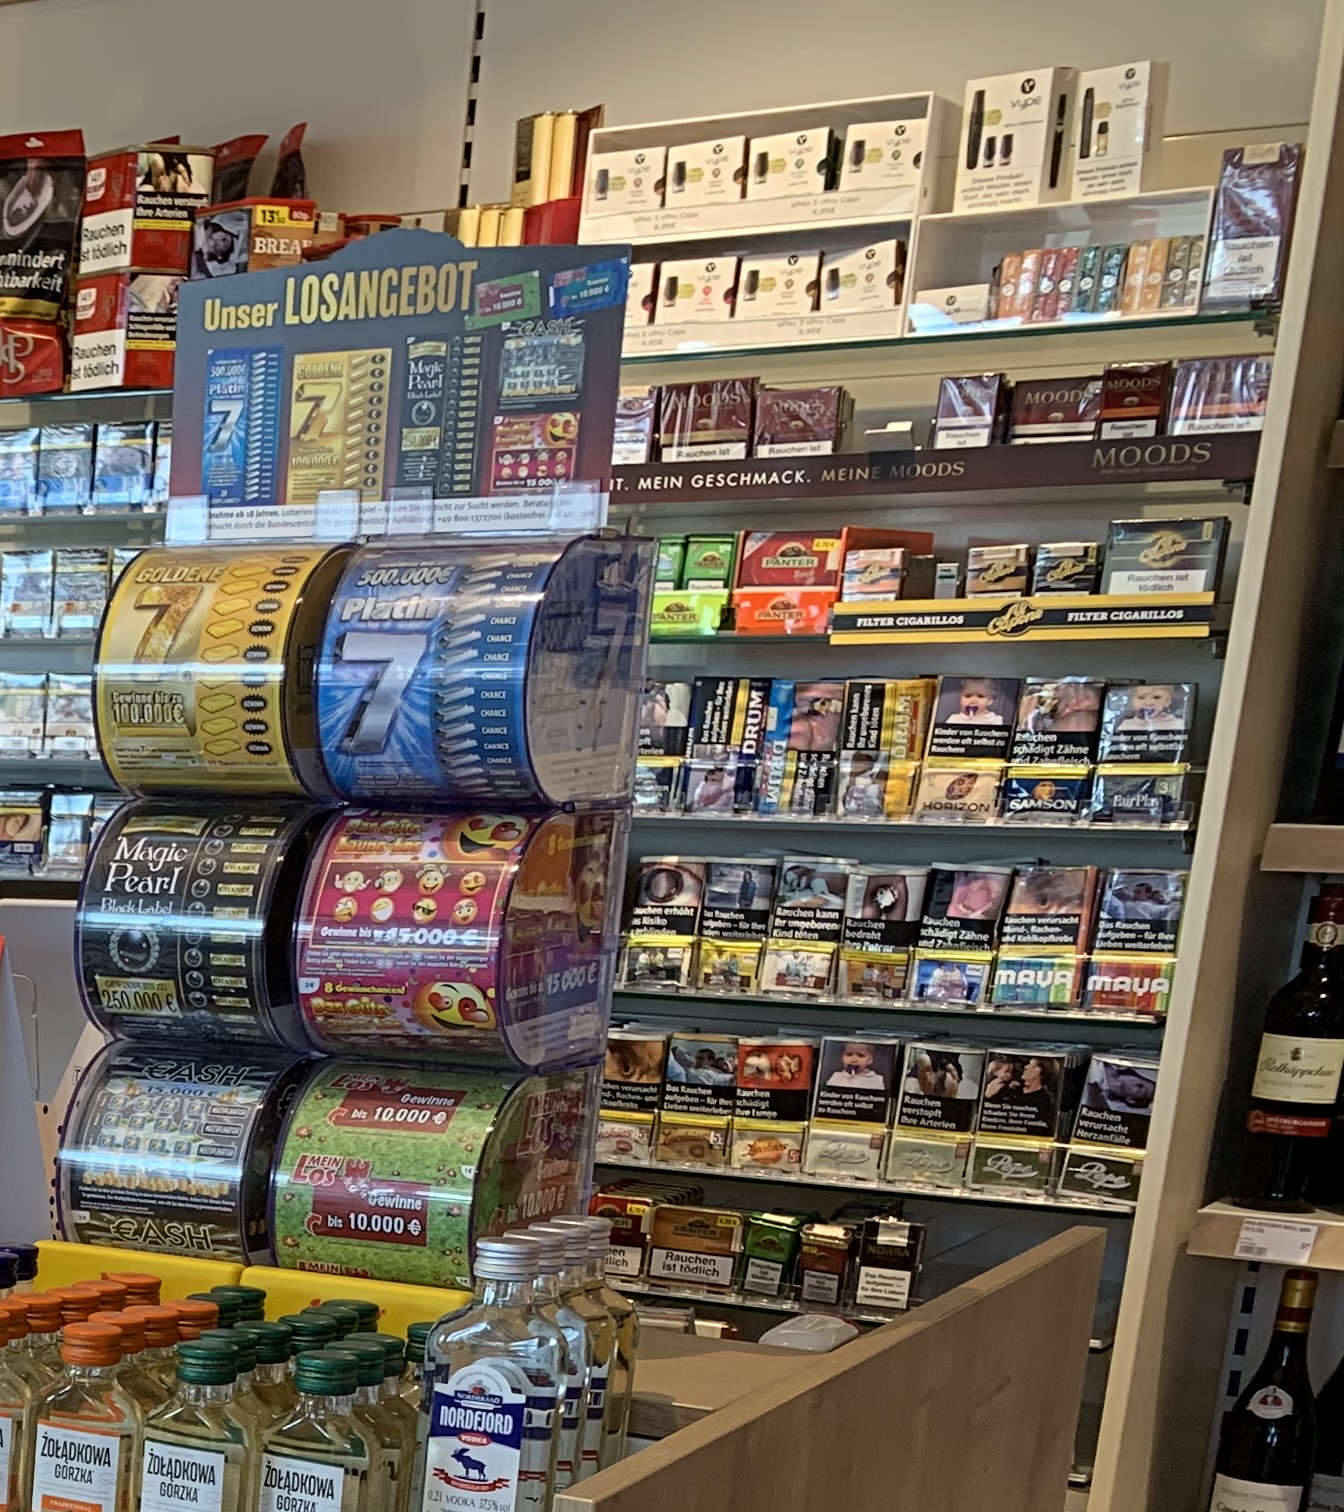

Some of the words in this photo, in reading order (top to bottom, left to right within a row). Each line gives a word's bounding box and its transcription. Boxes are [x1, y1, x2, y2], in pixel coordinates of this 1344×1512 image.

[204, 297, 278, 331] Unser
[285, 261, 478, 325] LOSANGEBOT
[1093, 441, 1212, 467] MOODS
[637, 475, 681, 491] MEIN
[691, 469, 812, 489] GESCHMACK.
[821, 464, 880, 482] MEINE
[889, 459, 966, 478] MOODS
[135, 565, 222, 585] GOLDENE
[340, 595, 440, 622] Platin
[1067, 610, 1109, 624] FILTER
[1111, 607, 1184, 623] CIGARILLOS
[856, 615, 891, 629] FILTER
[895, 613, 965, 628] CIGARILLOS
[133, 586, 203, 682] 7
[112, 692, 151, 707] Gewinne
[153, 692, 168, 705] bis
[170, 693, 182, 705] zu
[336, 631, 428, 756] 7
[742, 691, 767, 755] DRUM
[923, 800, 991, 814] HORIZON
[1010, 797, 1077, 812] SAMSON
[1113, 792, 1161, 808] FairPlay
[114, 835, 188, 865] Magic
[105, 861, 181, 896] Pearl
[101, 897, 135, 916] Black
[137, 900, 173, 917] Label
[320, 925, 357, 939] Gewinne
[400, 1092, 455, 1107] Gewinne
[350, 1108, 369, 1122] bis
[368, 1192, 423, 1212] Gewinne
[327, 1214, 343, 1230] bis
[665, 1251, 717, 1268] Rauchen
[662, 1261, 678, 1273] ist
[681, 1263, 720, 1280] tödlich
[439, 1403, 514, 1436] NORDFJORD
[461, 1433, 488, 1444] VODKA
[40, 1432, 112, 1468] ŻOŁĄDKOWA
[146, 1452, 217, 1487] ŻOŁĄDKOWA
[263, 1459, 336, 1501] ŻOŁĄDKOWA
[159, 1481, 199, 1503] GORZKA
